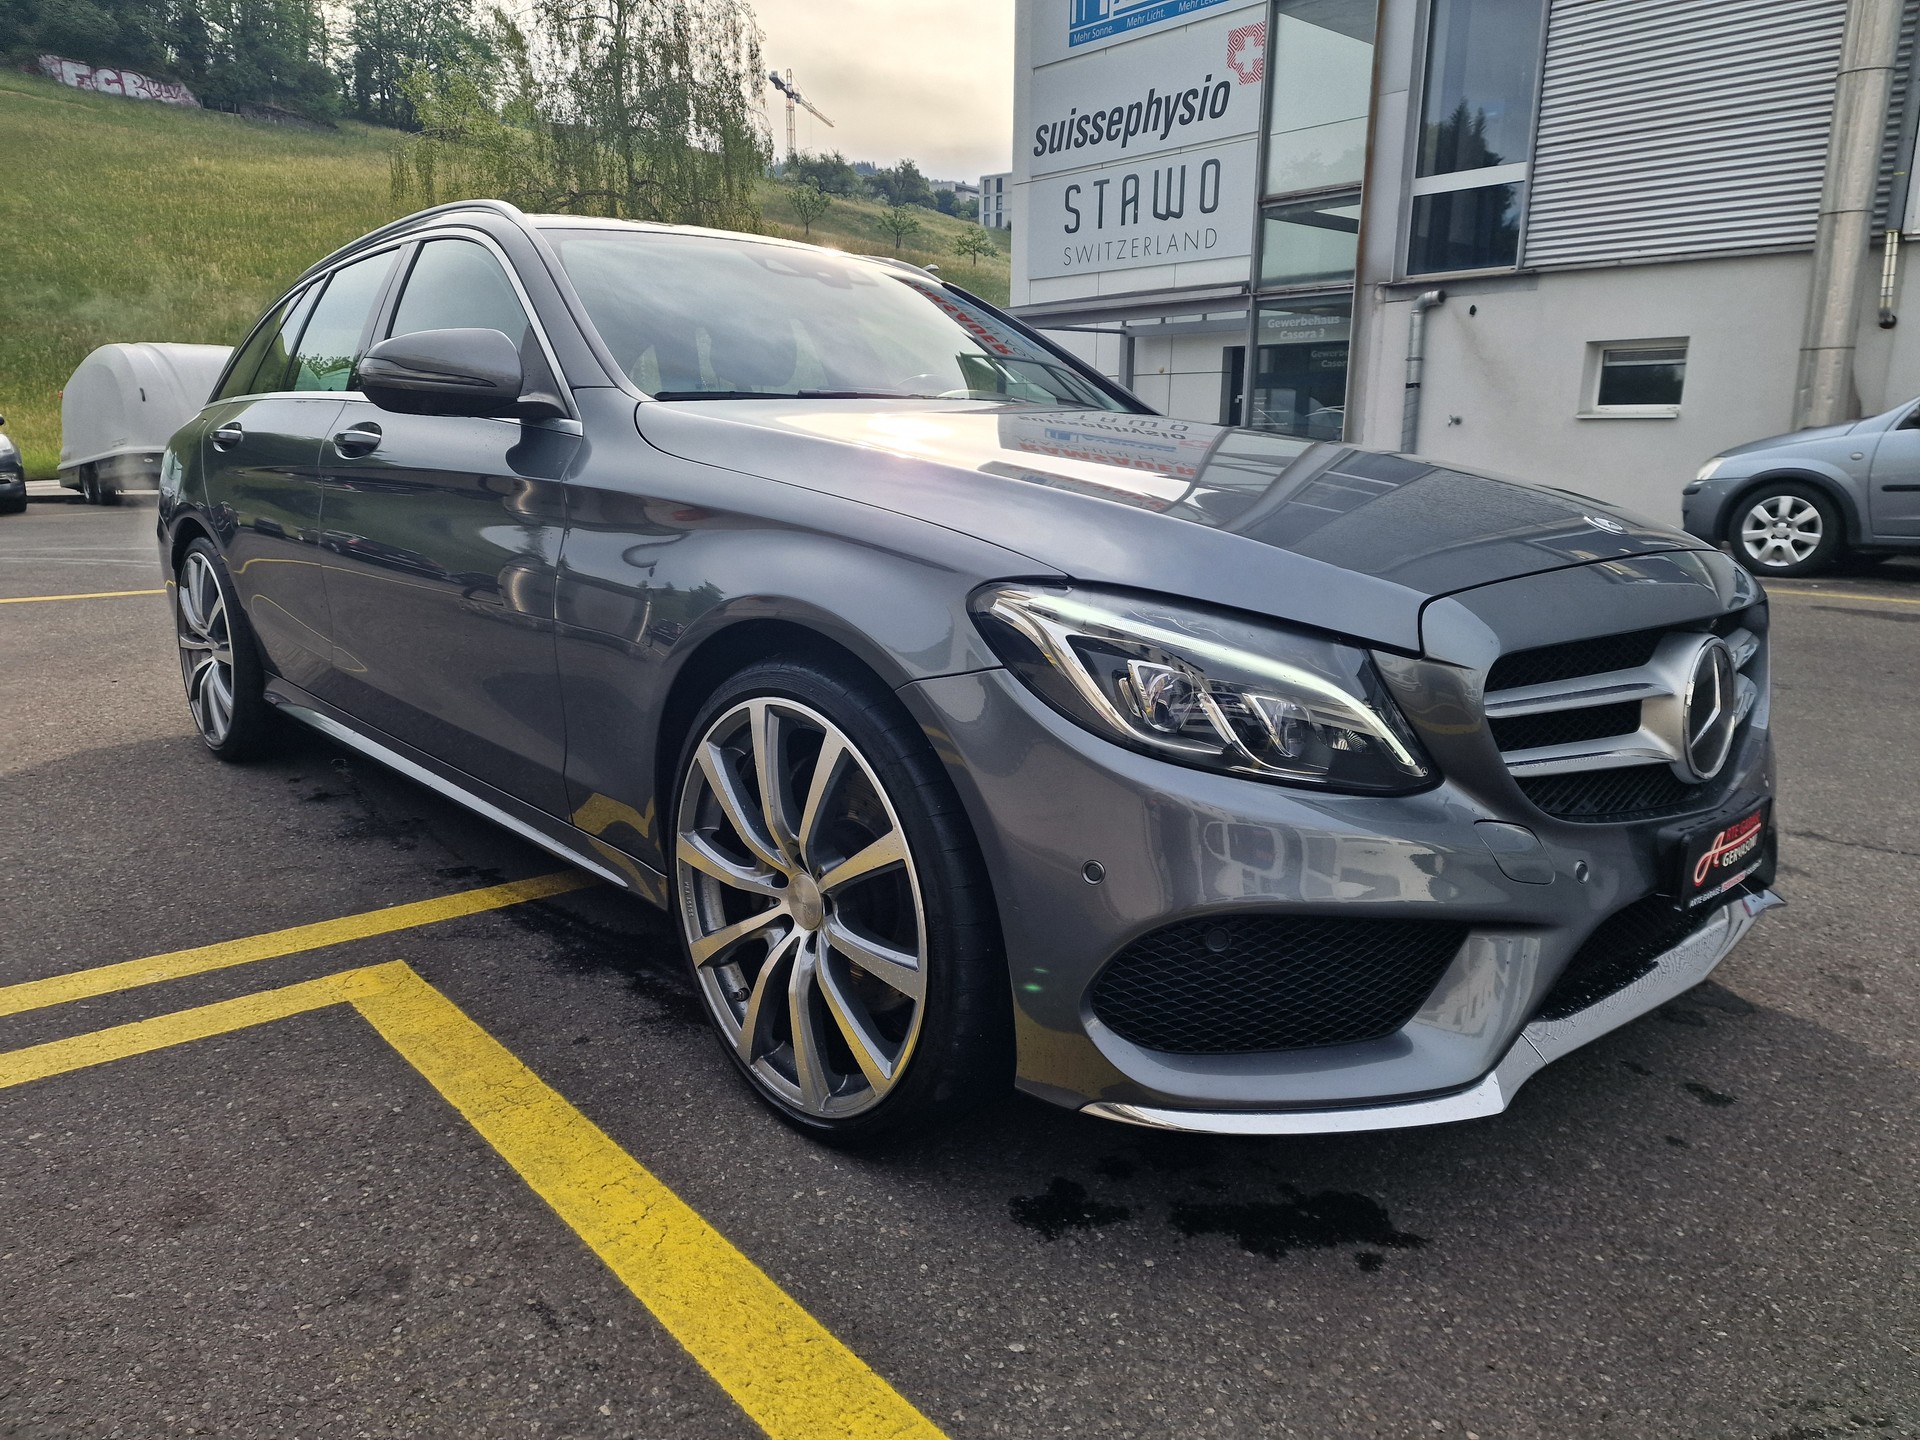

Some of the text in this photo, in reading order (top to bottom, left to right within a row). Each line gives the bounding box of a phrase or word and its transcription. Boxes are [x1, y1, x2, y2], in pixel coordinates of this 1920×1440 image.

[1073, 31, 1091, 44] Mehr
[1092, 25, 1115, 39] Sonne.
[1126, 15, 1145, 28] Mehr
[1146, 8, 1166, 21] Licht.
[1178, 0, 1198, 13] Mehr
[1034, 74, 1231, 157] suissephysio
[1064, 158, 1221, 234] STAWO
[1063, 228, 1218, 266] SWITZERLAND
[1267, 316, 1340, 328] Gewerbehaus
[1280, 328, 1325, 339] Casora 3
